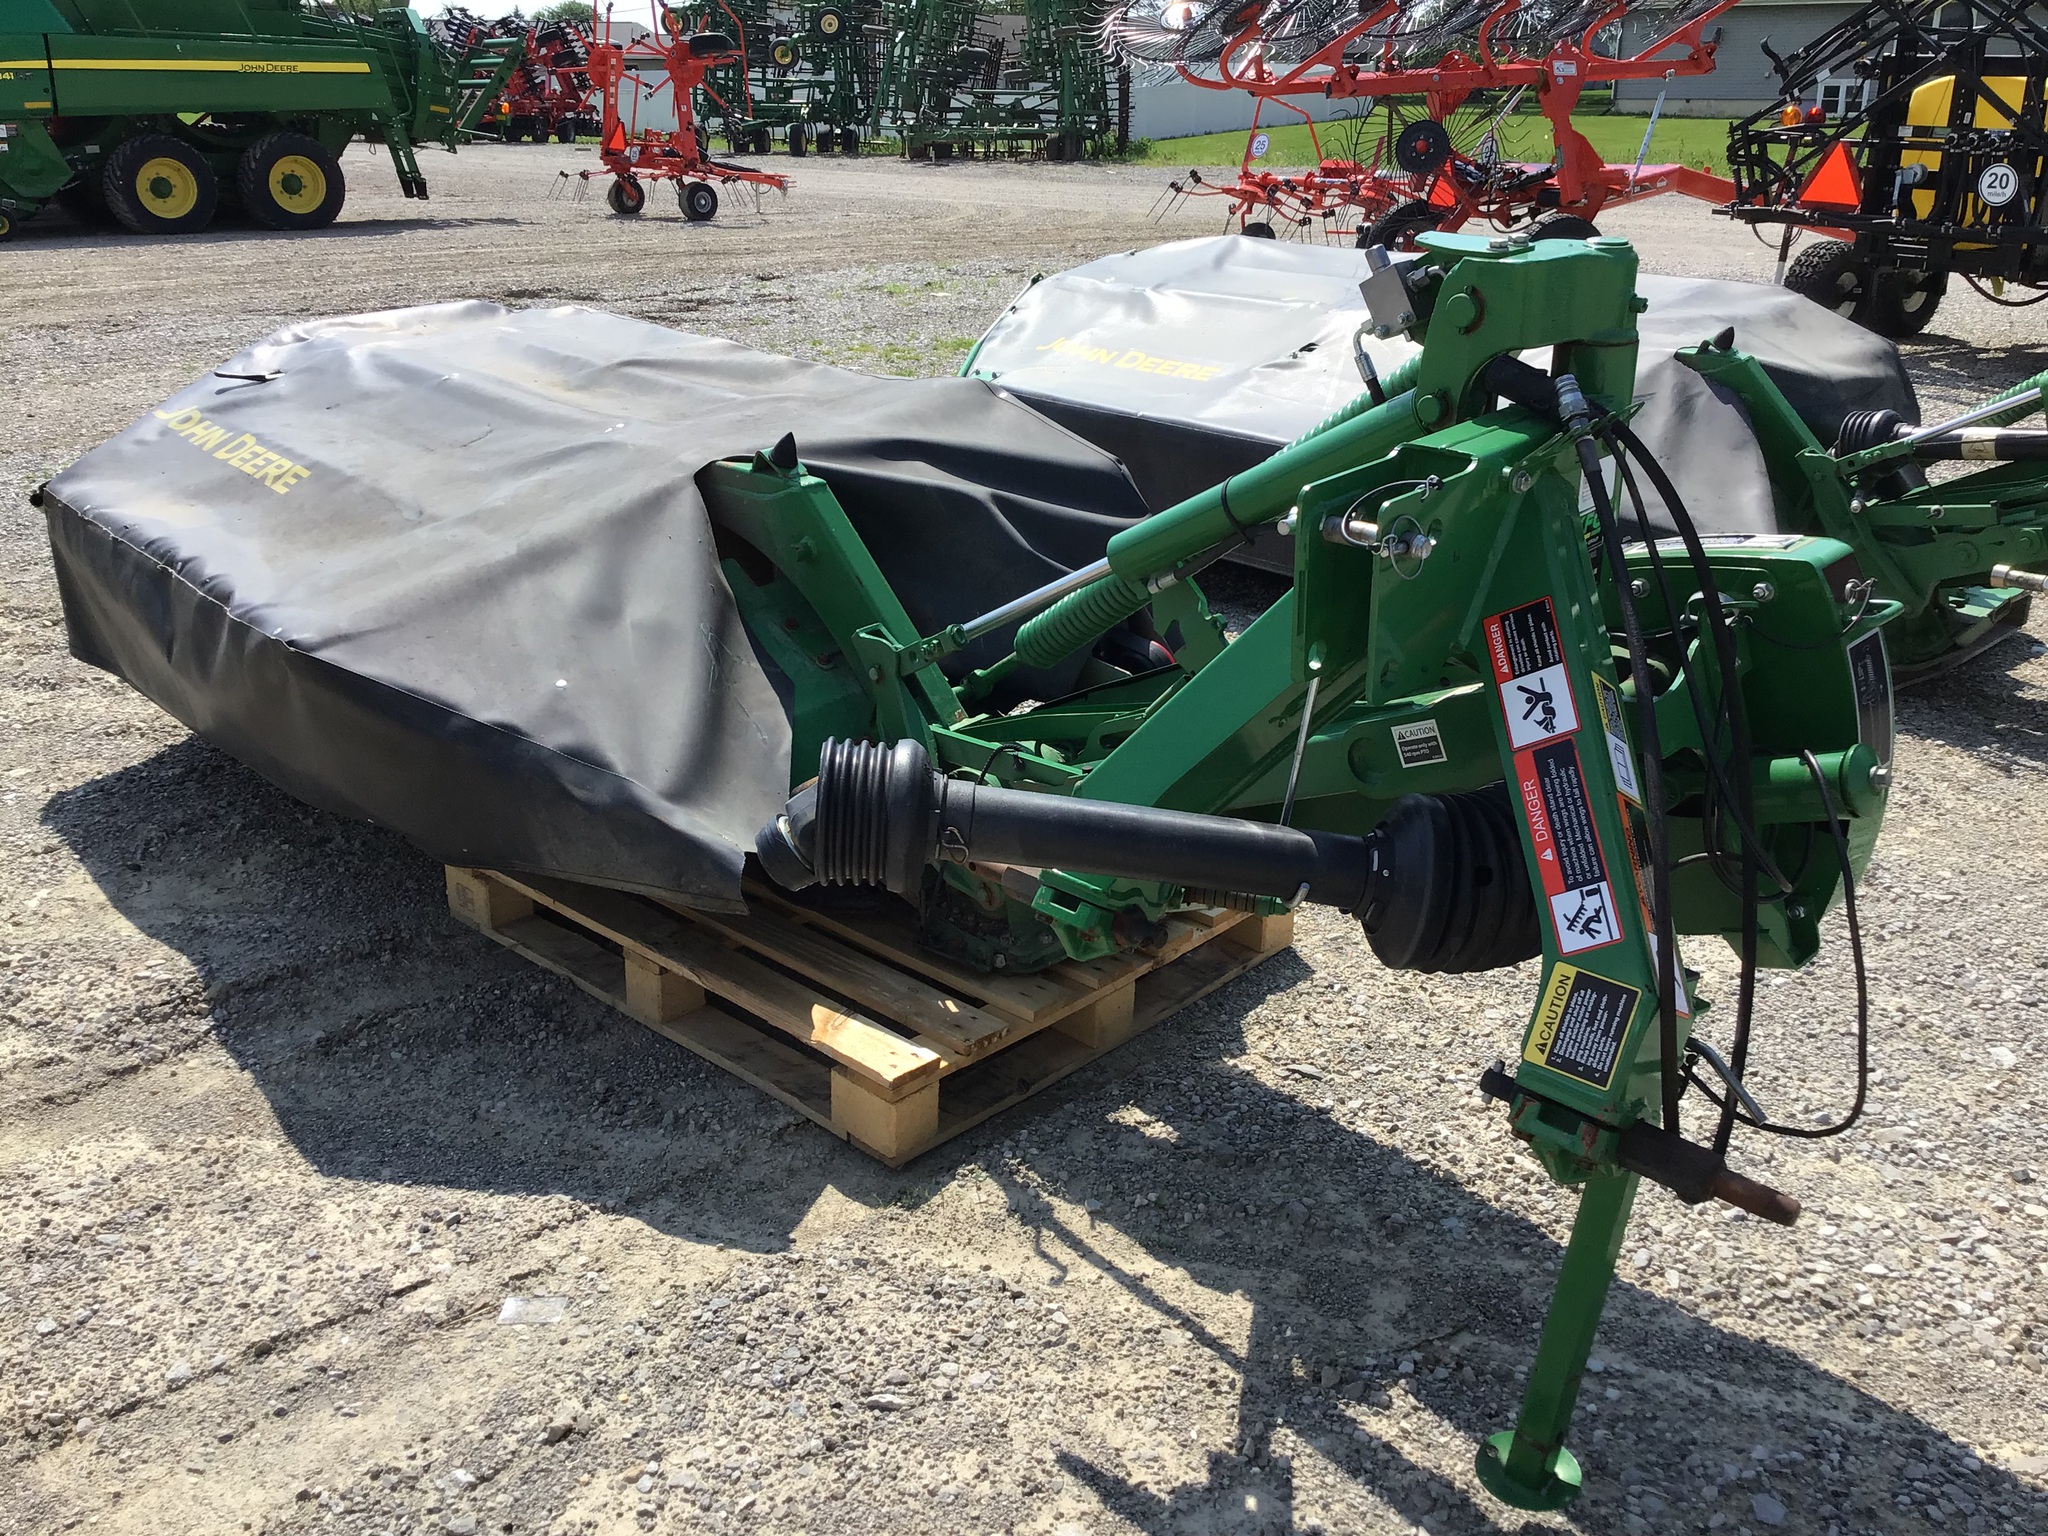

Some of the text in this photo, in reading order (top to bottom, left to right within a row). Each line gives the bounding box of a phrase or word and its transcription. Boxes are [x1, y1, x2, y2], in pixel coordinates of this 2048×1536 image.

[239, 63, 298, 72] JOHN DEERE
[1255, 140, 1266, 150] 25
[1987, 172, 2010, 190] 20
[1036, 336, 1222, 382] JOHN DEERE
[154, 406, 312, 495] JOHN DEERE
[1491, 624, 1506, 666] DANGER
[1404, 726, 1435, 738] CAUTION
[1402, 744, 1418, 752] Operate
[1548, 759, 1557, 778] folded
[1544, 778, 1552, 792] clear
[1554, 779, 1562, 797] being
[1560, 768, 1571, 796] hydraulic
[1524, 780, 1548, 841] DANGER
[1547, 793, 1556, 811] stand
[1577, 798, 1582, 806] to
[1552, 812, 1561, 830] death
[1561, 809, 1569, 827] wings
[1568, 805, 1581, 840] Mechanical
[1579, 806, 1587, 825] wings
[1566, 828, 1574, 846] when
[1584, 826, 1592, 842] allow
[1560, 839, 1568, 856] injury
[1563, 857, 1572, 874] avoid
[1570, 847, 1581, 874] machine
[1592, 857, 1600, 877] failure
[1568, 876, 1574, 884] To
[1540, 974, 1570, 1041] CAUTION
[1553, 1040, 1562, 1053] Keep
[1562, 1014, 1571, 1032] shields
[1570, 992, 1578, 1008] place.
[1565, 1040, 1574, 1057] engine
[1571, 1022, 1580, 1039] and/or
[1583, 989, 1591, 1005] power
[1597, 1062, 1603, 1070] Do
[1604, 1038, 1612, 1051] leave
[1609, 1017, 1620, 1037] running
[1616, 994, 1627, 1016] machine
[1559, 1028, 1572, 1055] Disengage
[1570, 1043, 1579, 1059] before
[1577, 1019, 1588, 1042] servicing
[1580, 1026, 1591, 1049] machine.
[1580, 1050, 1589, 1063] Keep
[1586, 1032, 1596, 1049] hands,
[1590, 1043, 1598, 1057] away
[1594, 1030, 1602, 1042] from
[1592, 1036, 1606, 1068] driven parts.
[1604, 1042, 1617, 1072] unattended.
